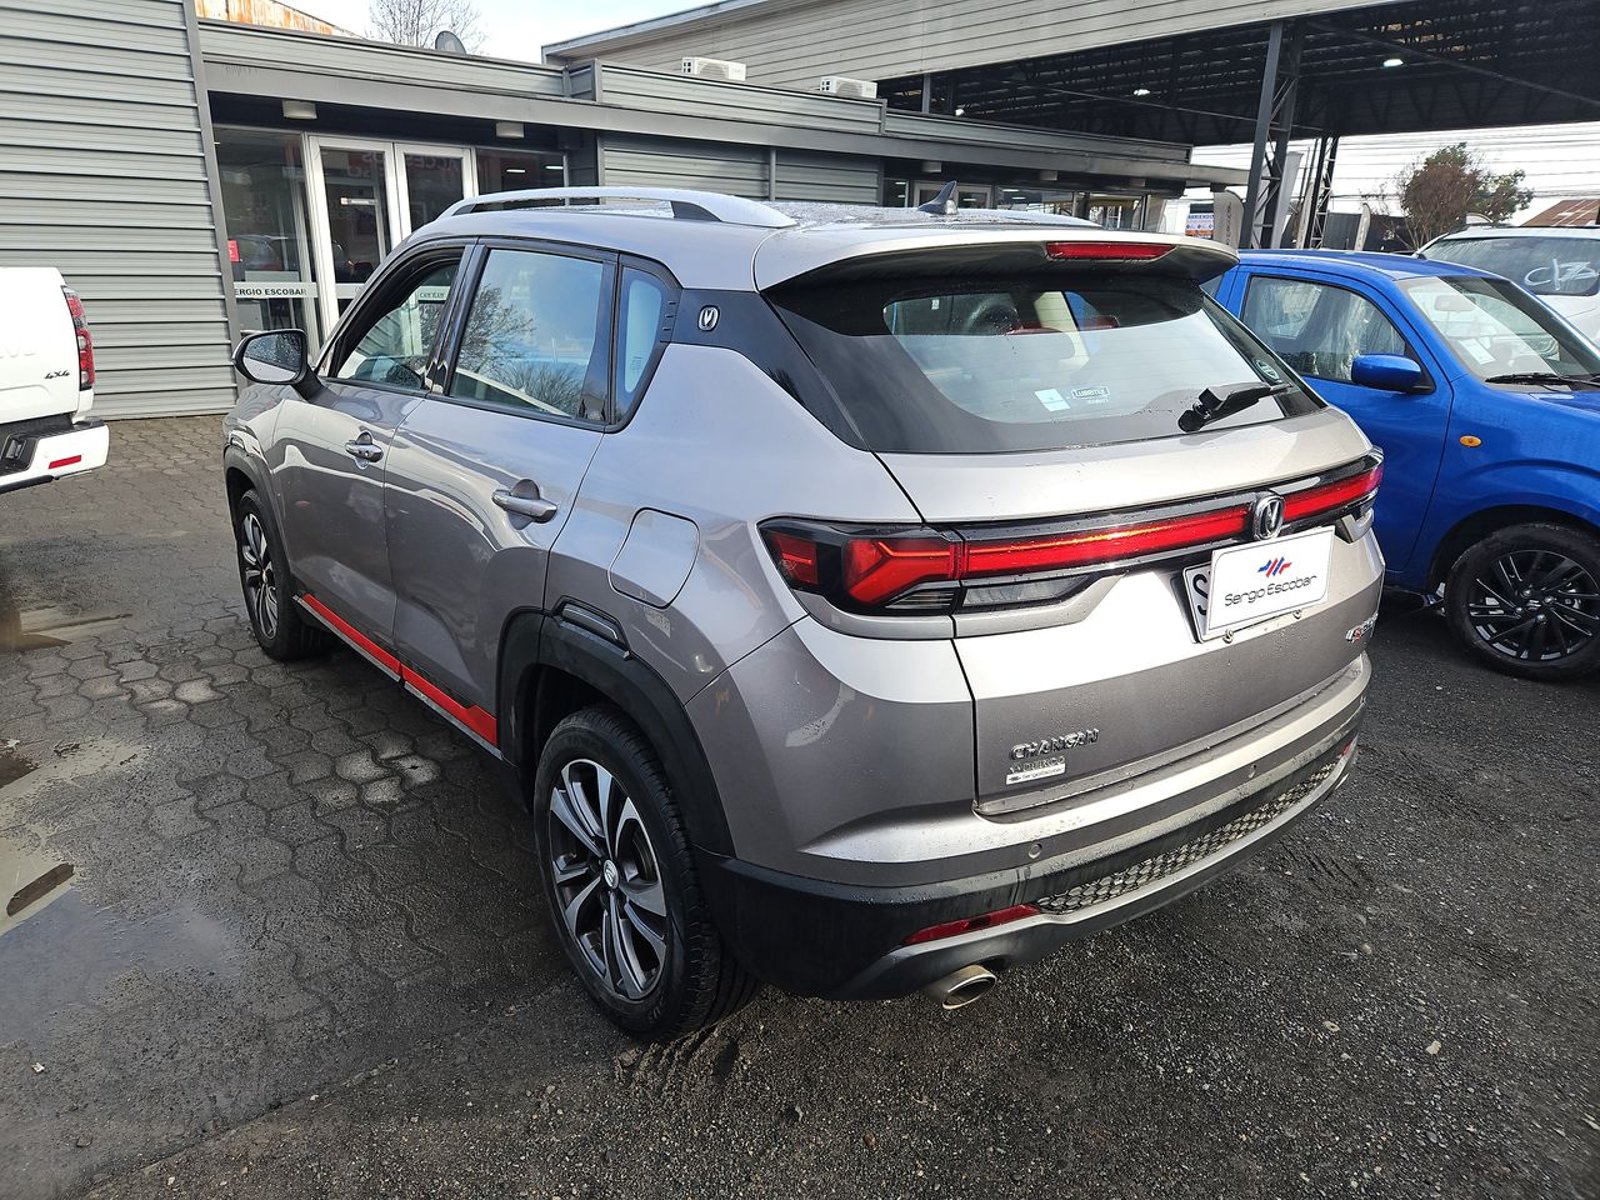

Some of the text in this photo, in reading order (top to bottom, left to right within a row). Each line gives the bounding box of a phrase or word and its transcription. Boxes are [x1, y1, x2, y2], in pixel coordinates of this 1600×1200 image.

[235, 288, 307, 296] ERGIO ESCOBAR
[1224, 574, 1318, 607] Sergio Escobar
[1008, 727, 1100, 761] CHANGAN
